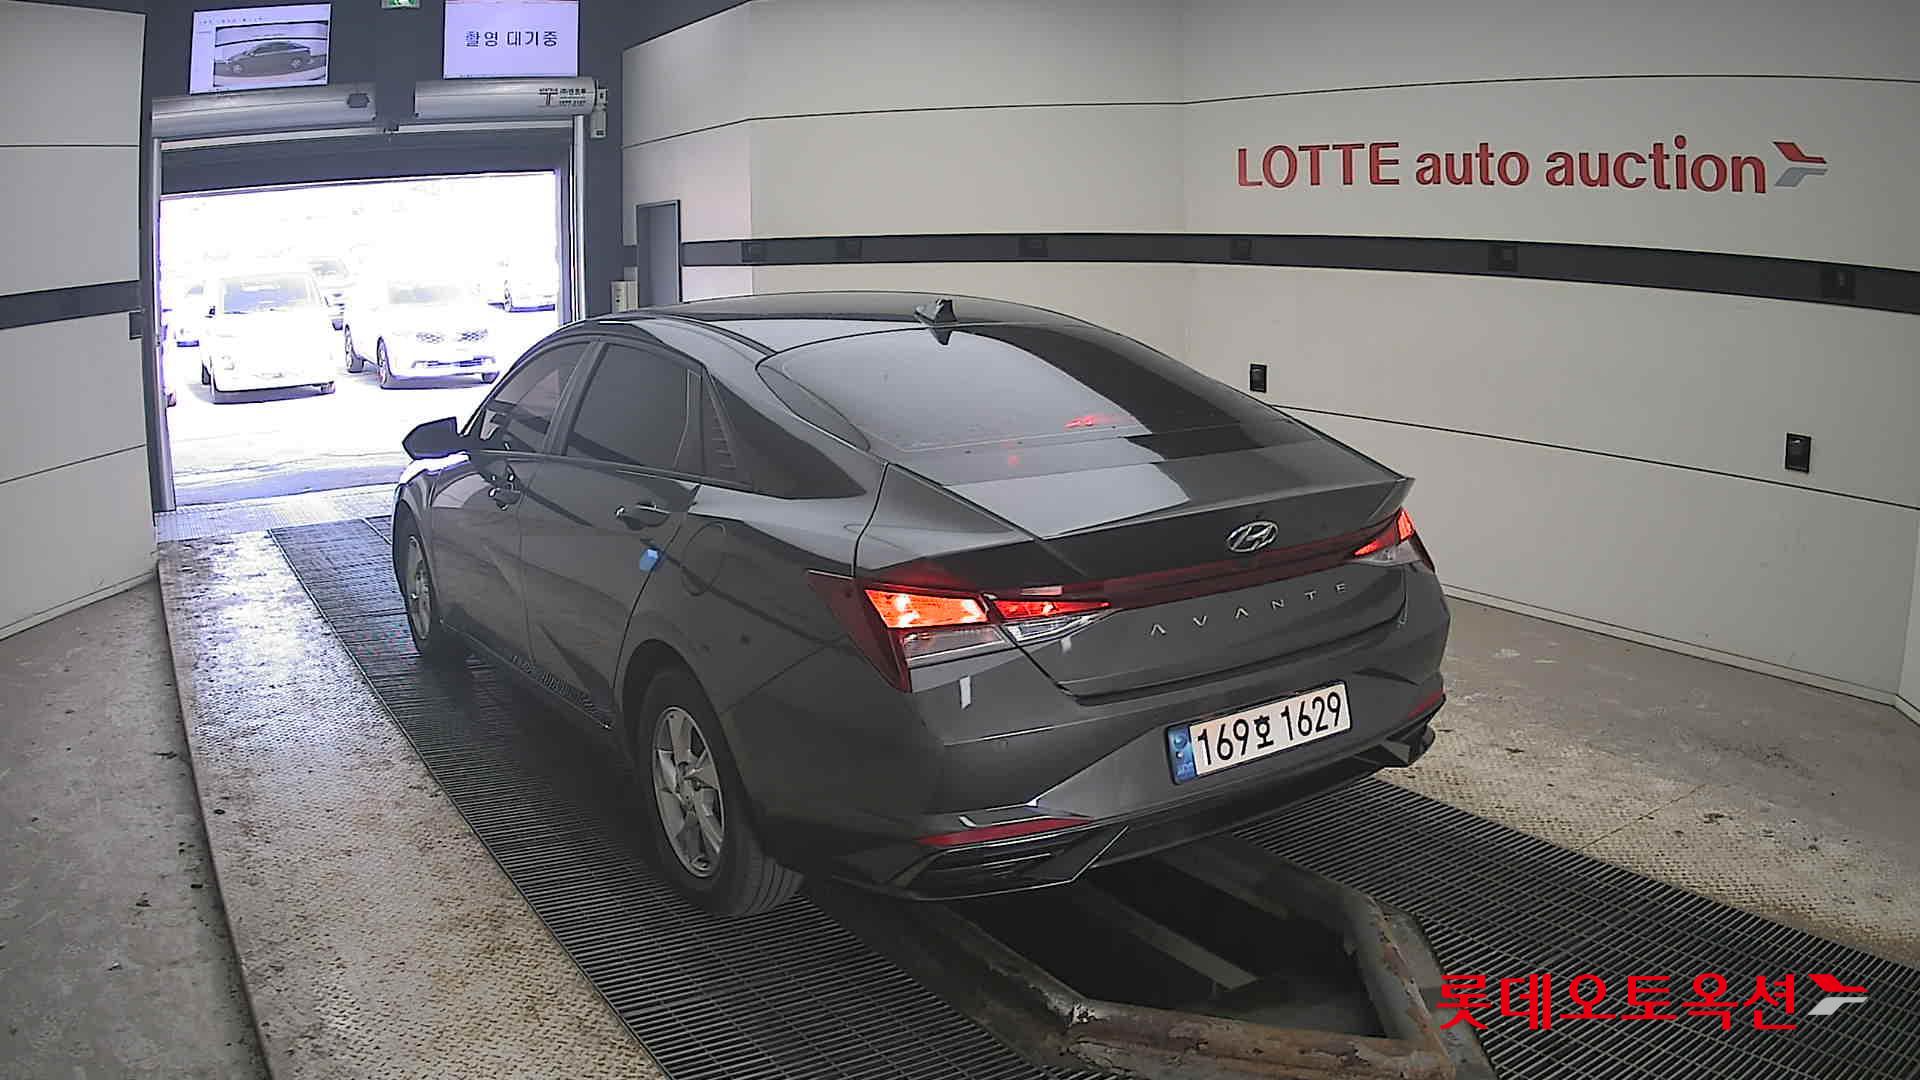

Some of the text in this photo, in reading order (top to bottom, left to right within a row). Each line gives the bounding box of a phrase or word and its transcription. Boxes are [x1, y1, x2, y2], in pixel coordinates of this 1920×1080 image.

[507, 31, 558, 47] 대기중
[1238, 134, 1767, 194] LOTTE auto auction
[1150, 583, 1346, 636] AVANTE
[1197, 691, 1341, 766] 169호 1629
